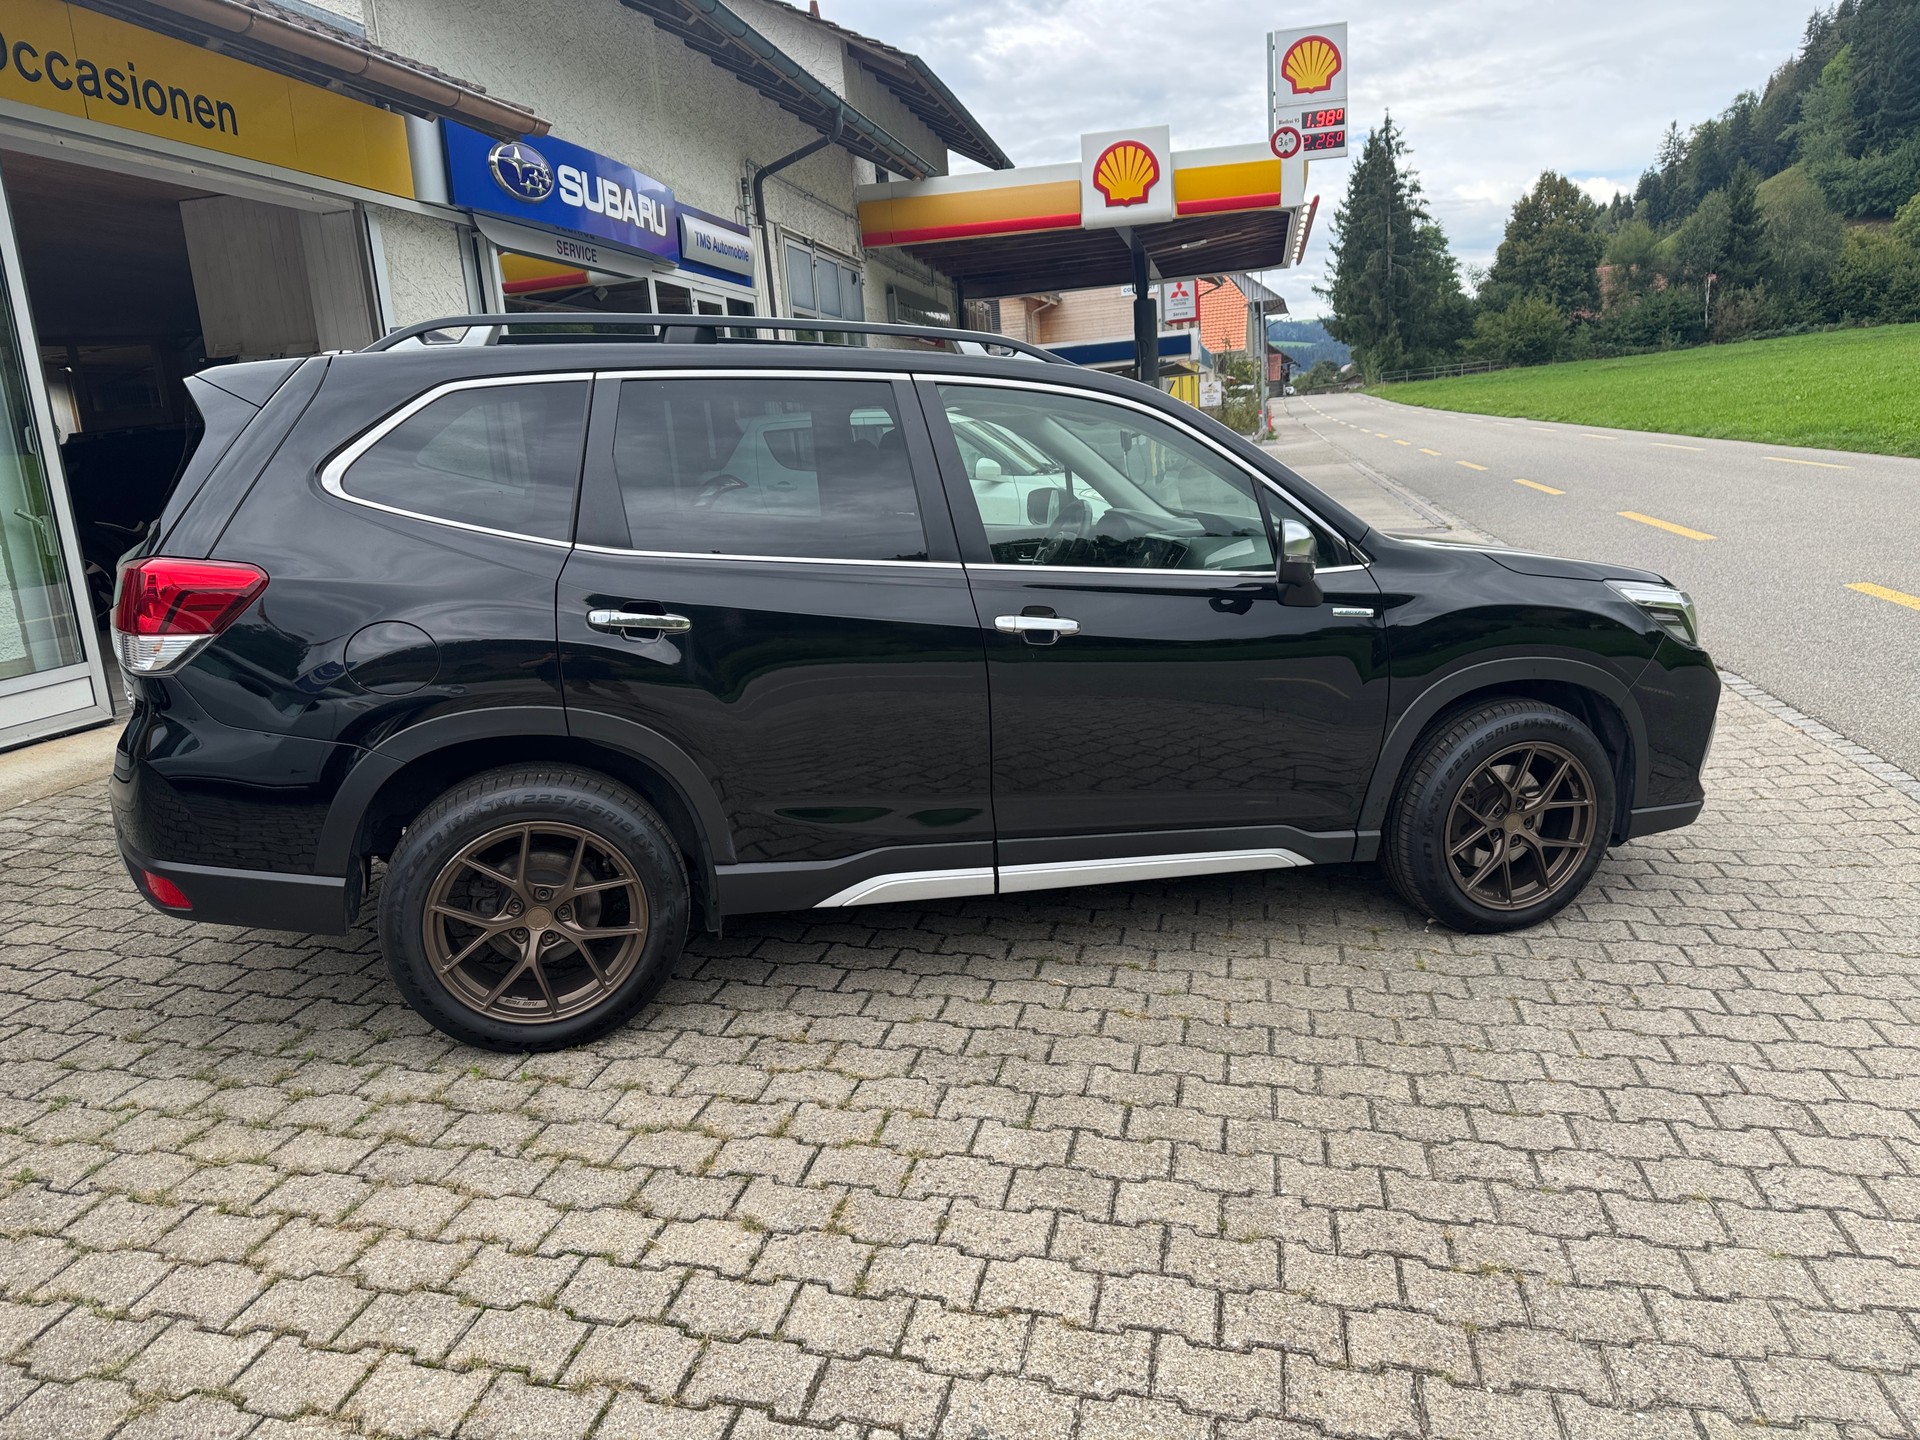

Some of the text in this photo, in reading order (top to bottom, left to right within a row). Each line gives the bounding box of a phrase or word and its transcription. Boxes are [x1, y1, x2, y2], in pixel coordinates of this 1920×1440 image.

[557, 164, 667, 237] SUBARU
[556, 239, 598, 264] SERVICE
[695, 230, 749, 262] TMS Automobile
[1445, 720, 1520, 780] 225/55R18
[521, 793, 636, 833] 225/55R18
